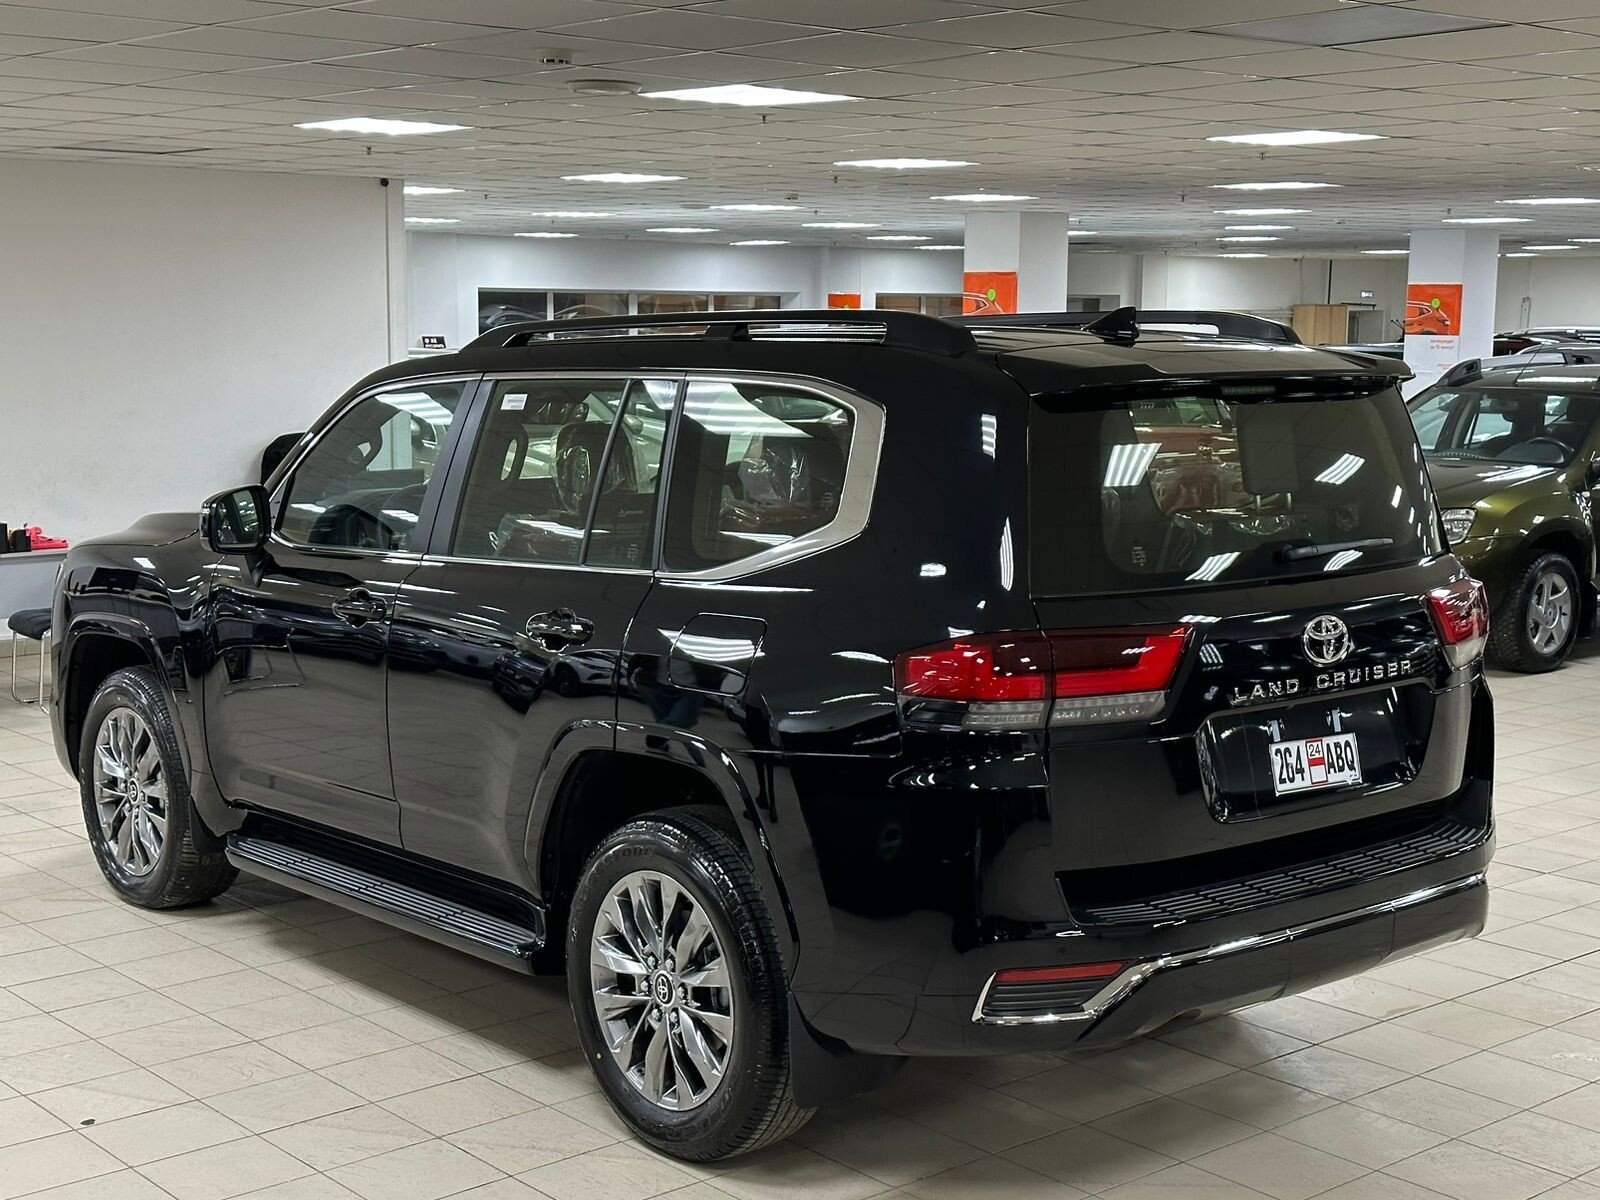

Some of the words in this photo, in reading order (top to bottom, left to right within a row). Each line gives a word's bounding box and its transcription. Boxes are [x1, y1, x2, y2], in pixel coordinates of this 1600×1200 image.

[1234, 679, 1300, 700] LAND
[1316, 660, 1413, 689] CRUISER
[1274, 745, 1306, 785] 264
[1308, 743, 1321, 757] 24
[1325, 739, 1357, 775] ABQ
